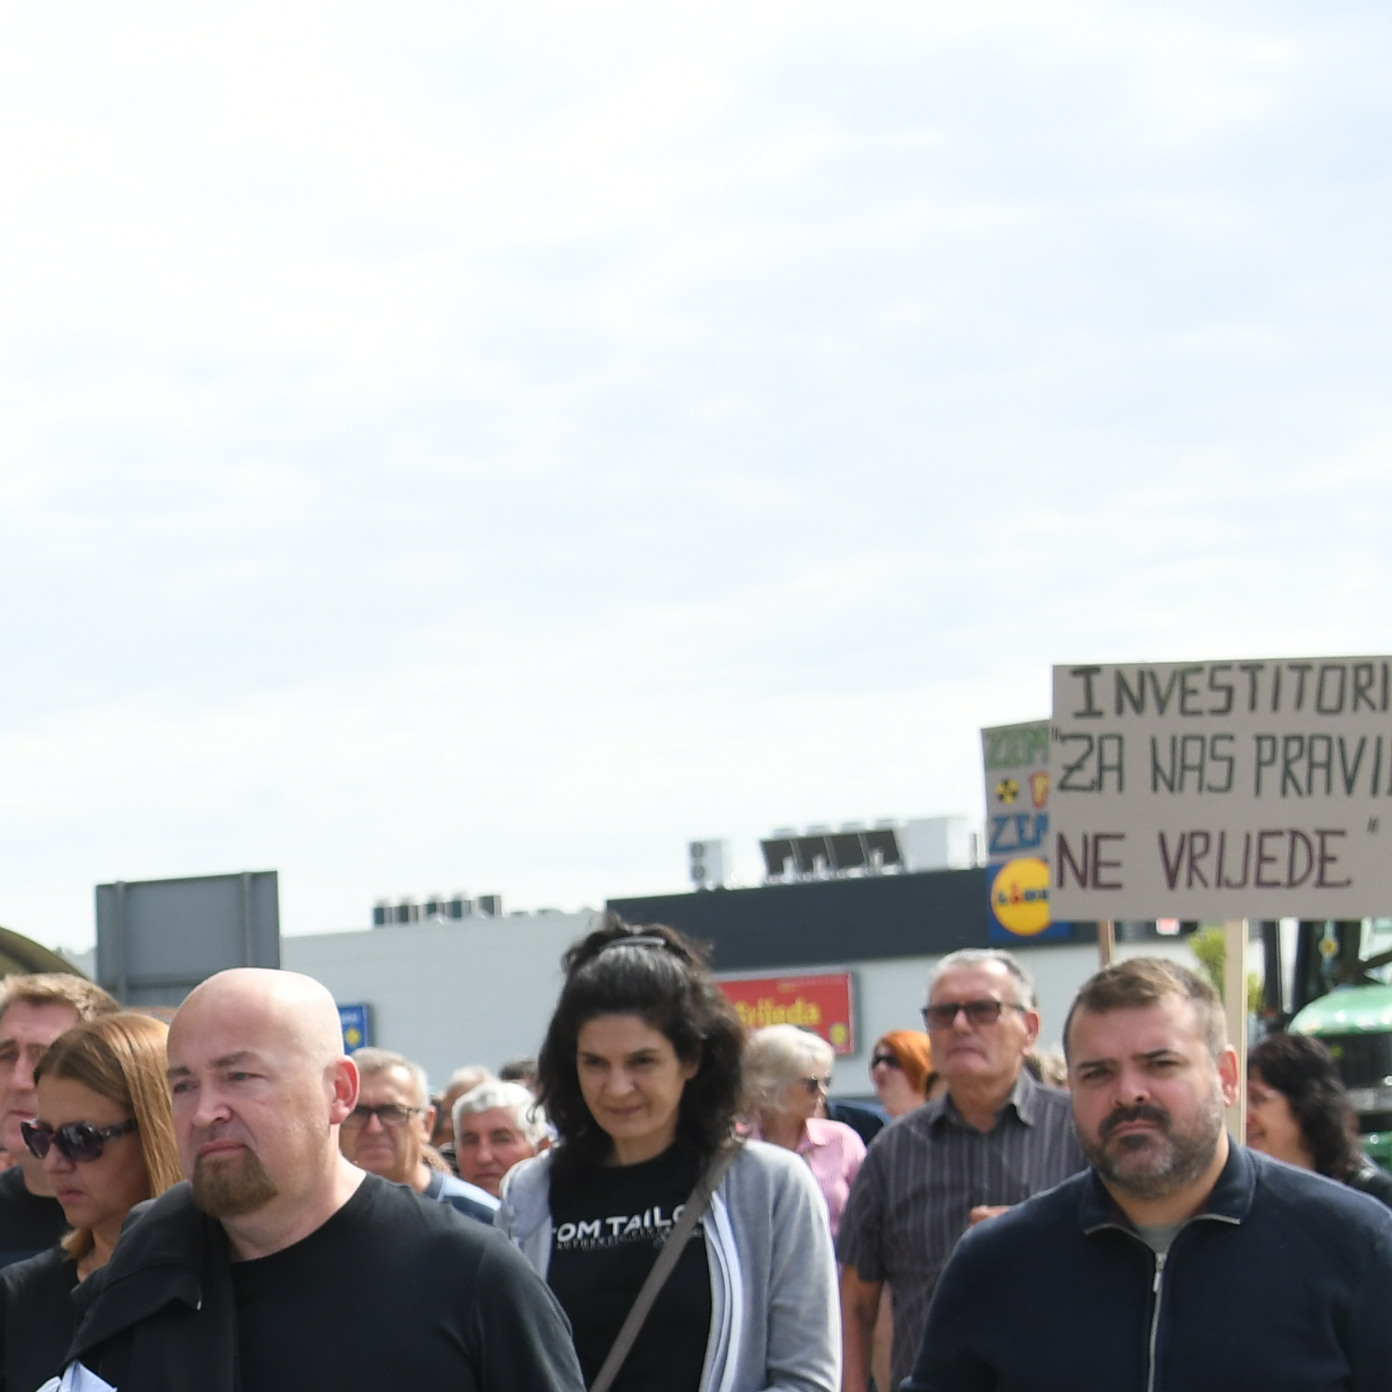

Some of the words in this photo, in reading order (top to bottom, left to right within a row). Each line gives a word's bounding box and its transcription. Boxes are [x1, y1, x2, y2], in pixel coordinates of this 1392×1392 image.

[1071, 663, 1390, 718] INVESTITORI
[1150, 733, 1236, 794] NAS
[1253, 733, 1392, 798] PRAVI
[1055, 831, 1127, 890] NE
[552, 1219, 601, 1244] OM
